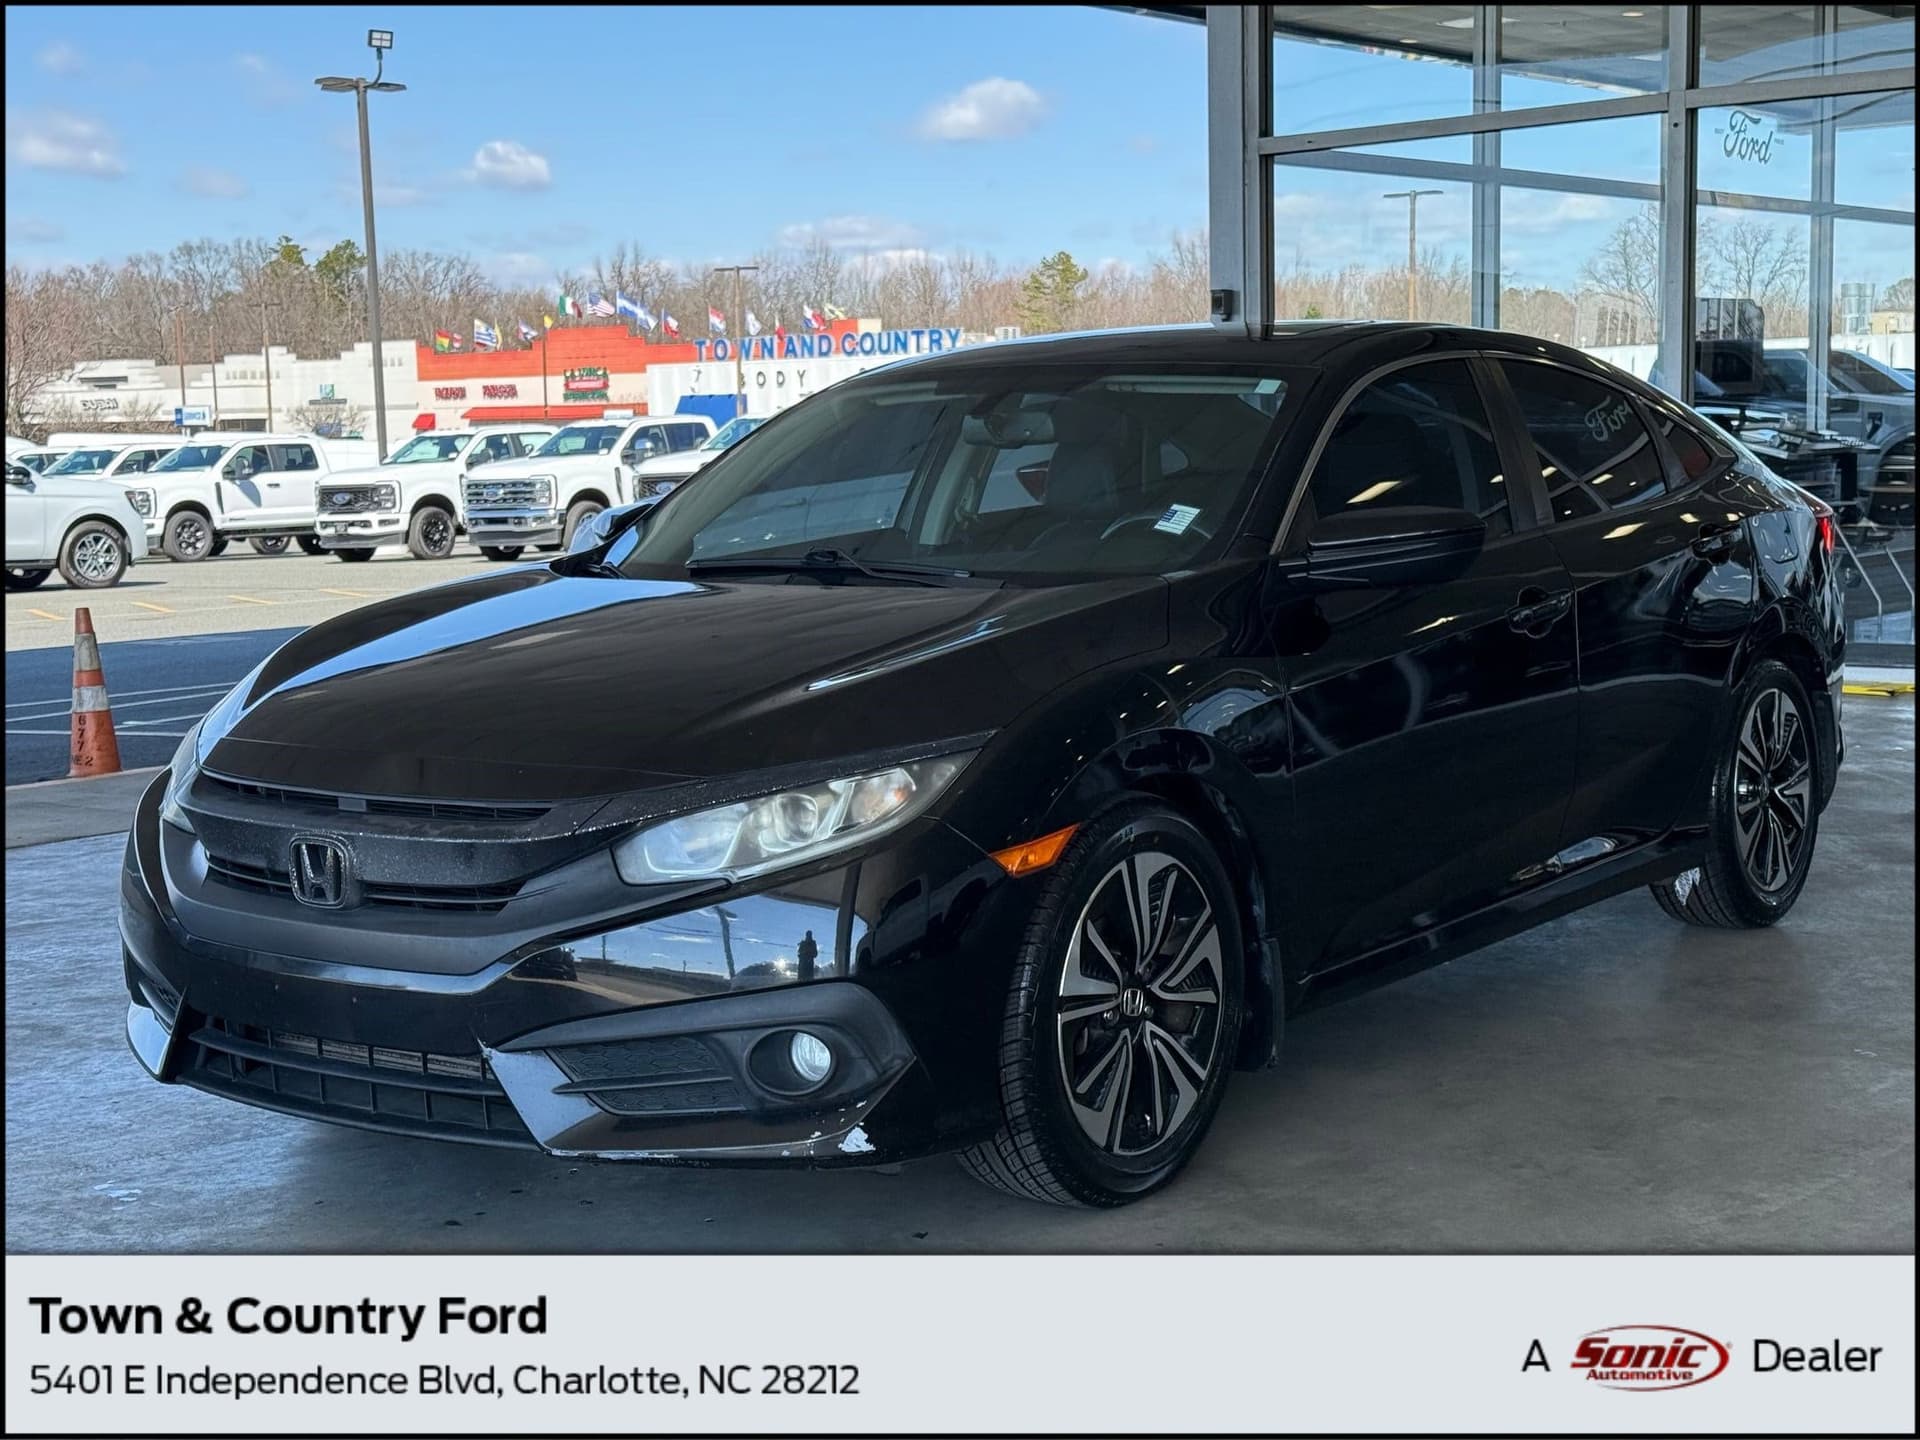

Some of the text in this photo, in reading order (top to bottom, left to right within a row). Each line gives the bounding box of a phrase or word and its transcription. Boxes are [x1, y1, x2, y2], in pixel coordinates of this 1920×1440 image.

[1723, 110, 1774, 165] Ford
[694, 328, 962, 362] TOWN AND COUNTRY
